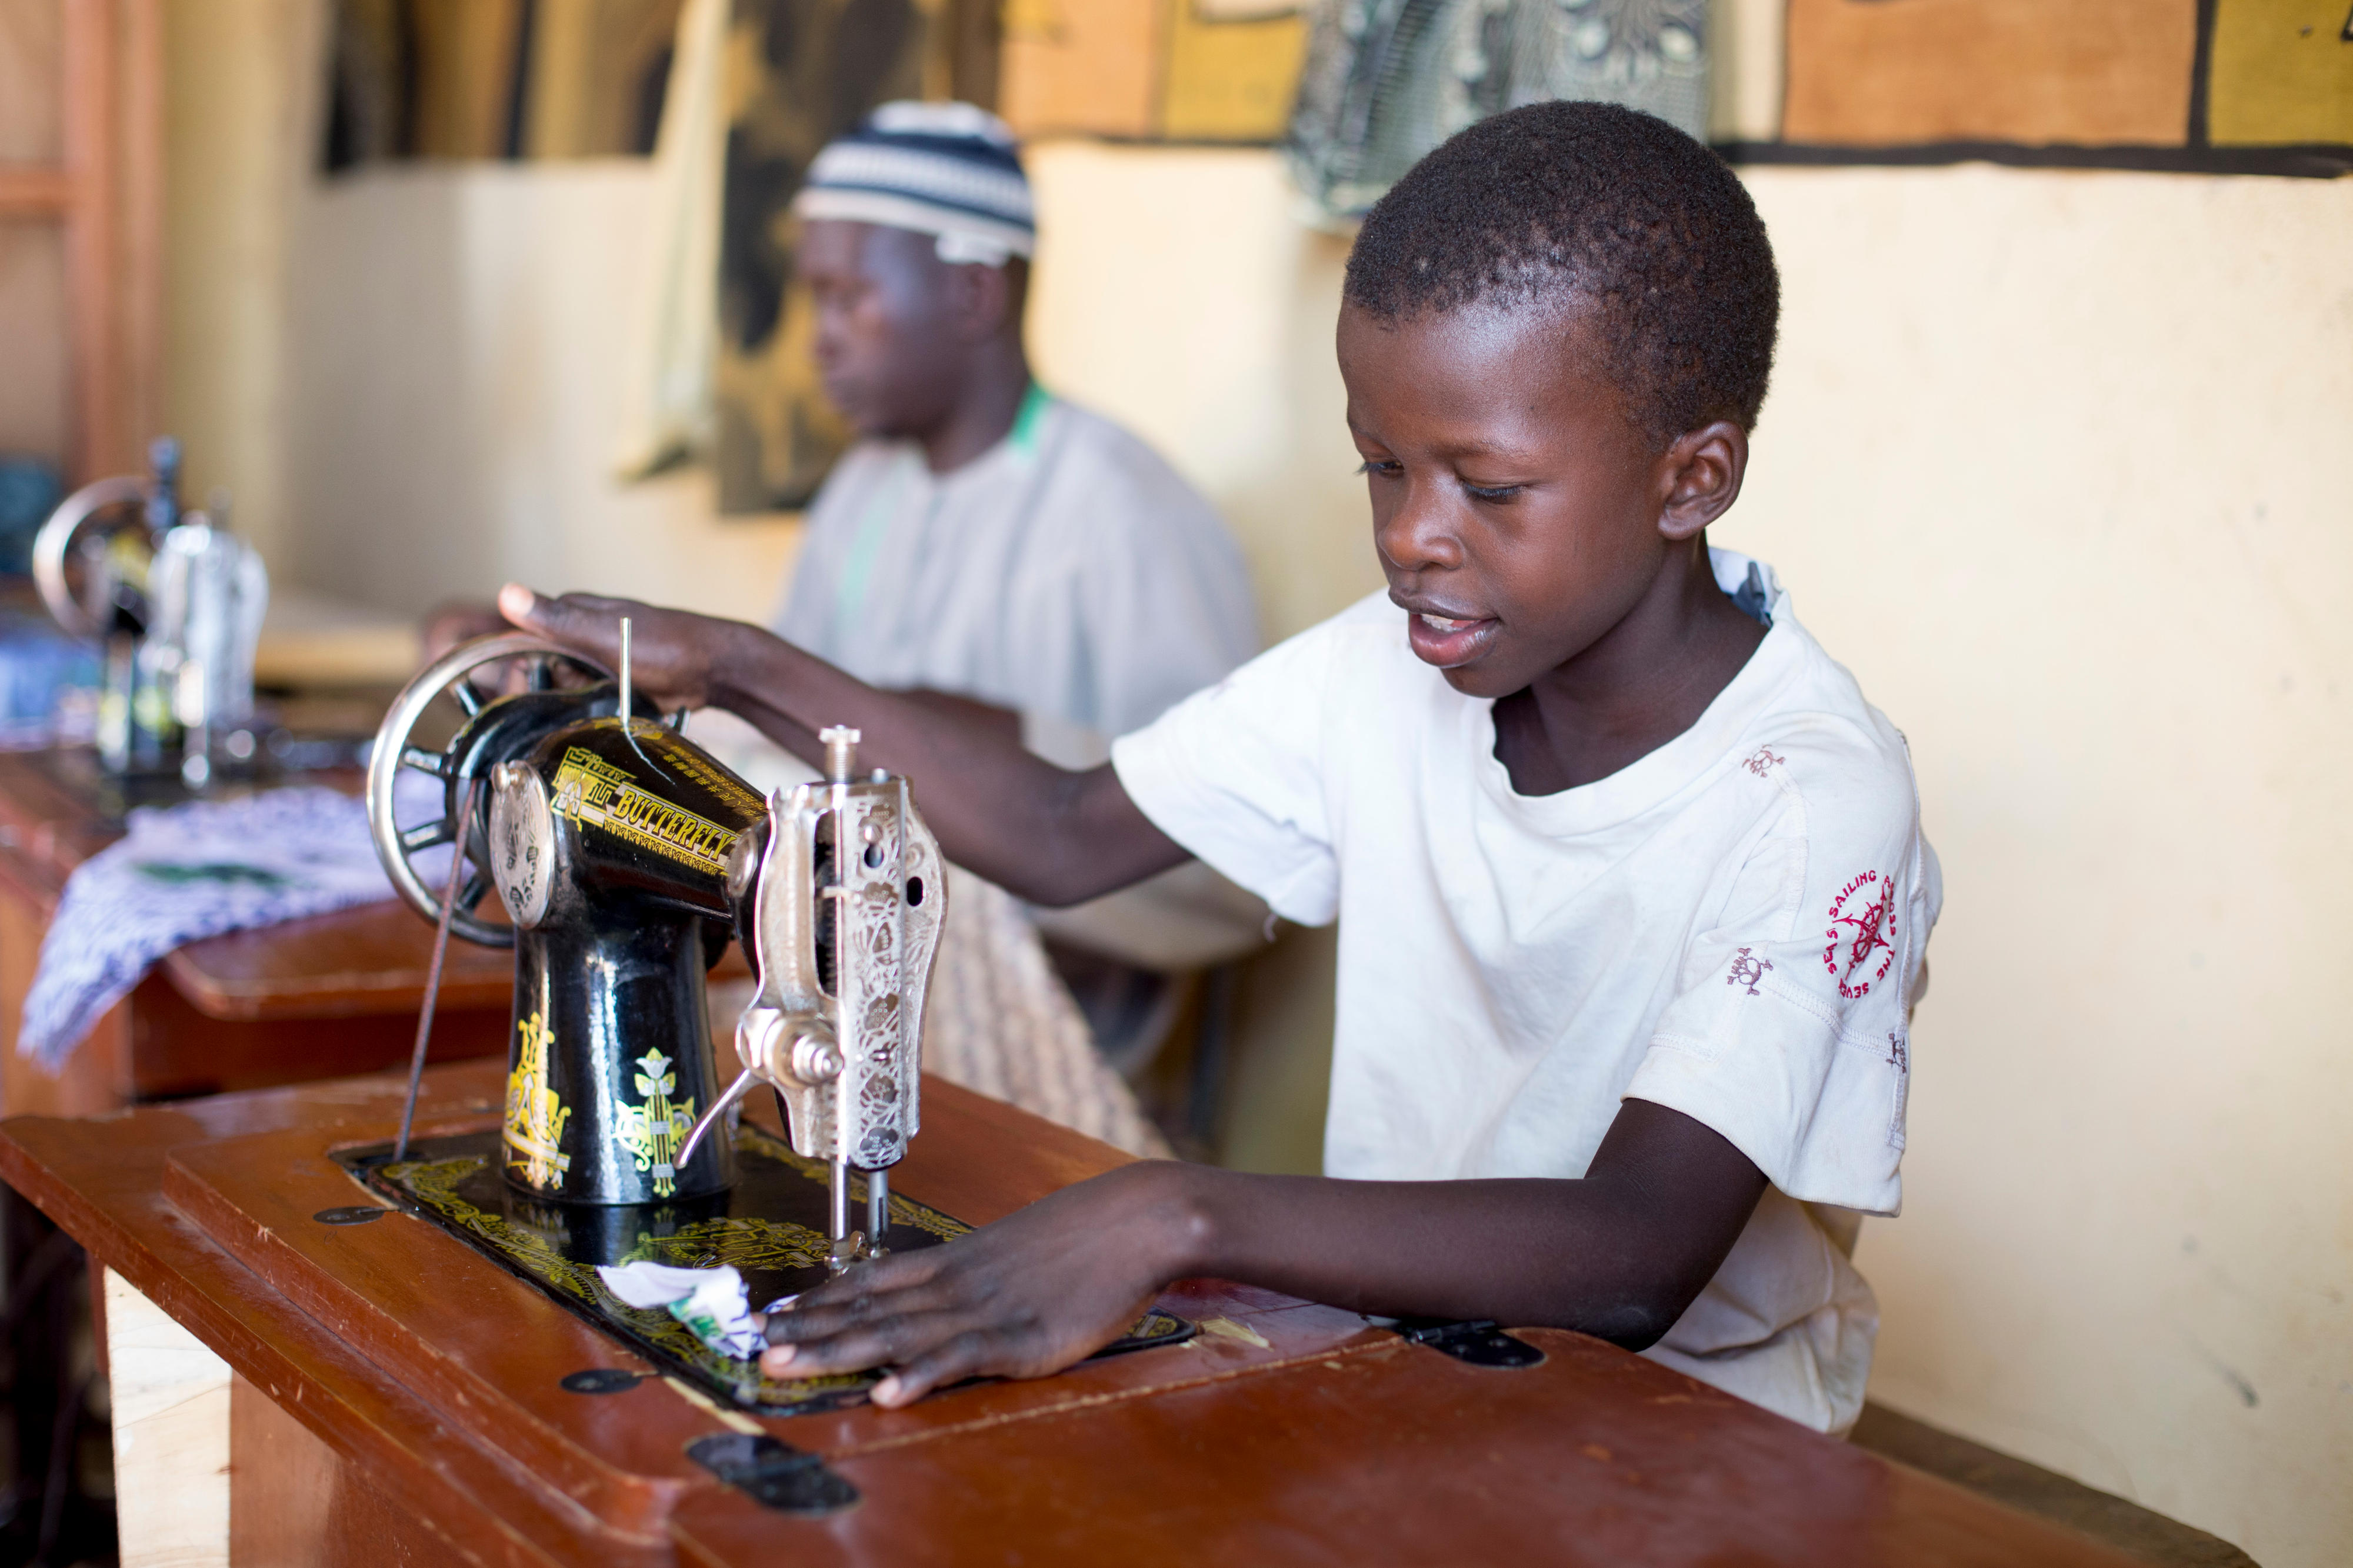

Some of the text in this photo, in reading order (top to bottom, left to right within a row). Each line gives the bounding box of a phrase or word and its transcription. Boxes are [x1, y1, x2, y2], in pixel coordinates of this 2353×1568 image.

[612, 789, 737, 862] BUTTERFLY
[1828, 870, 1877, 918] SAILING
[1884, 875, 1897, 936] AOSS
[1823, 928, 1838, 975] SEAS
[1877, 949, 1895, 982] THE
